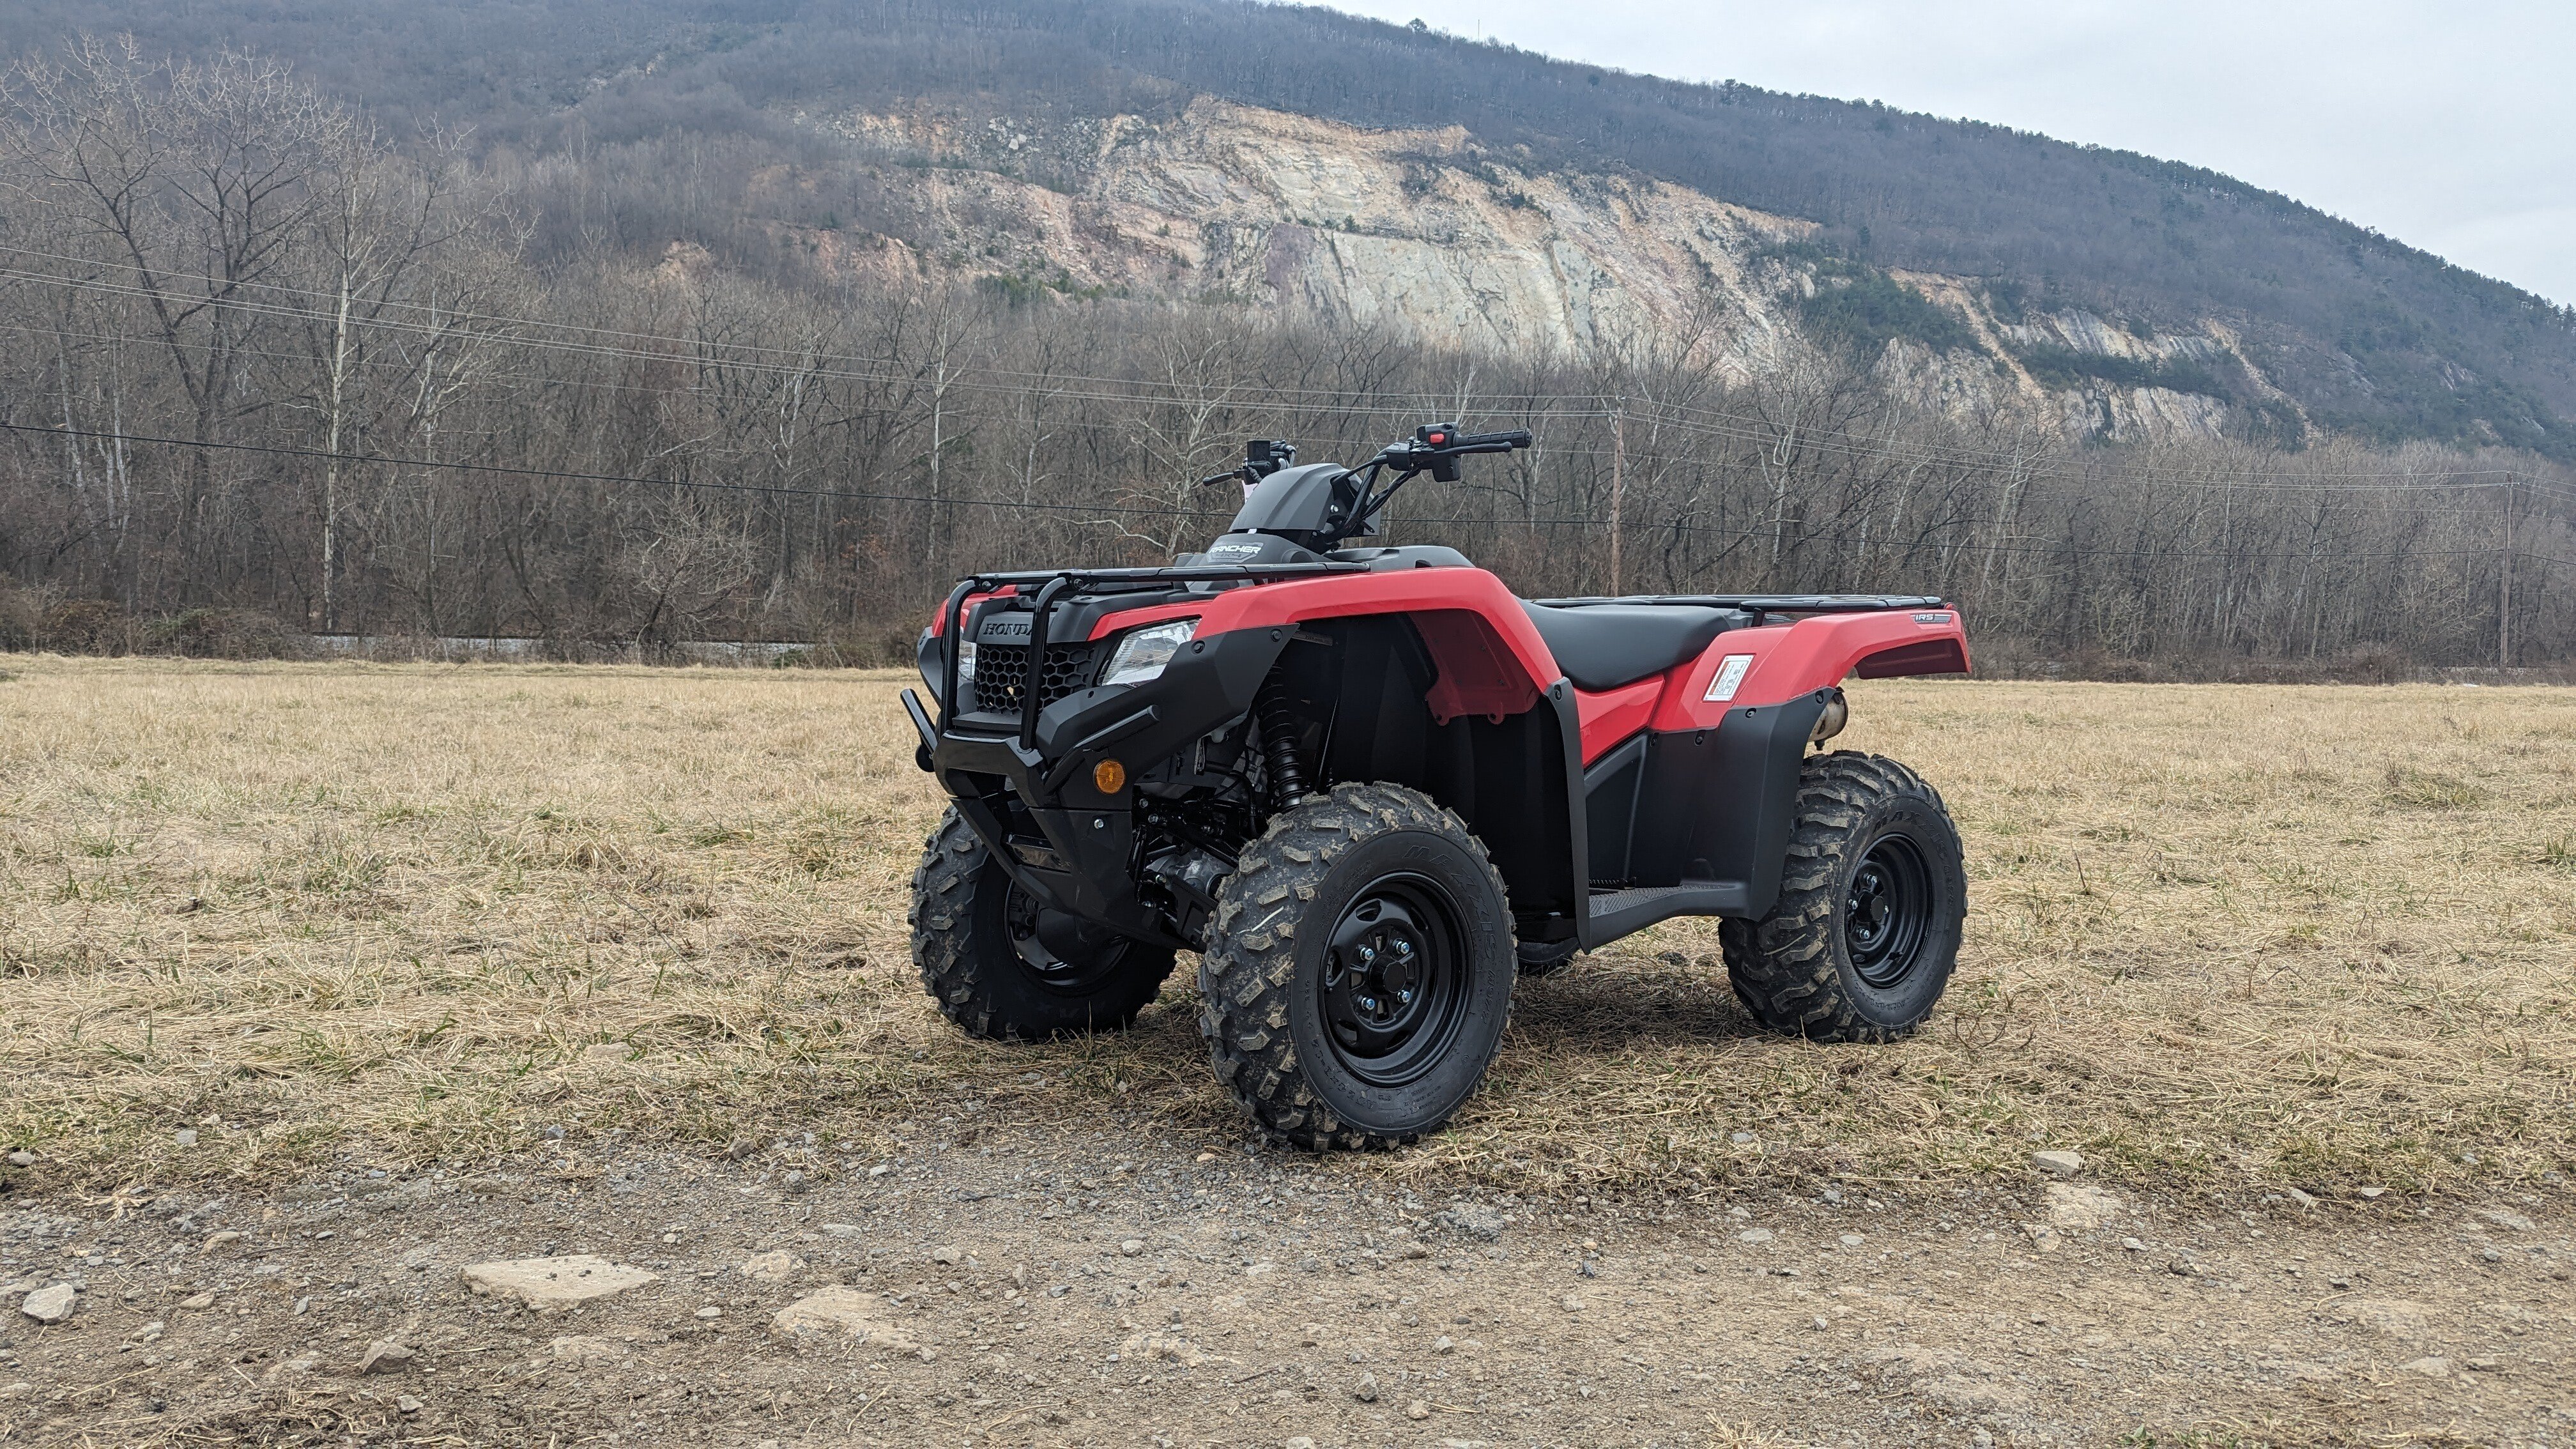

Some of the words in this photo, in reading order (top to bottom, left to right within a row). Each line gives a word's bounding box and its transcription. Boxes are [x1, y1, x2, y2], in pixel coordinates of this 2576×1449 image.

[1209, 545, 1261, 554] RANCHER
[983, 623, 1032, 636] HOND
[1402, 845, 1499, 960] MAXXIS
